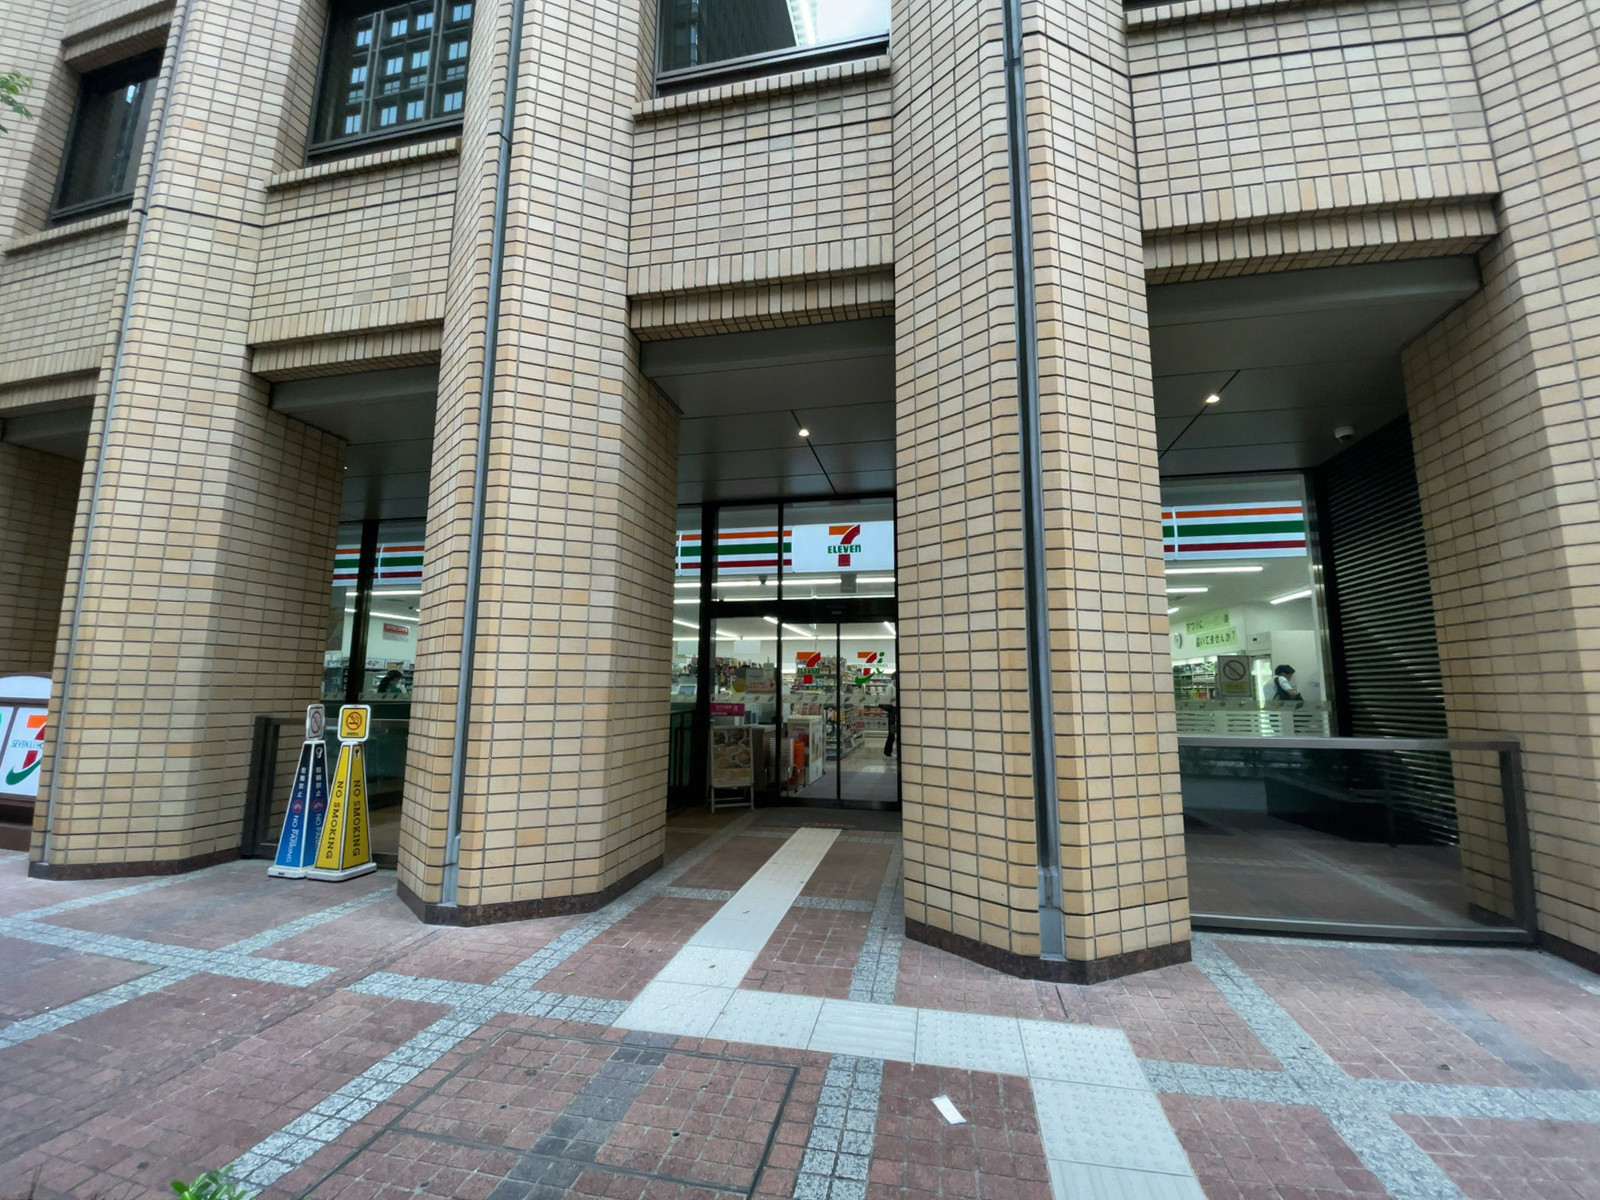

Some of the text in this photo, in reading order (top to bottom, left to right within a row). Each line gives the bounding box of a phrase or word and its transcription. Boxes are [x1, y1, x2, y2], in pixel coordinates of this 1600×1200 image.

[326, 781, 344, 859] NO SMOKING
[352, 780, 361, 857] NO SMOKING
